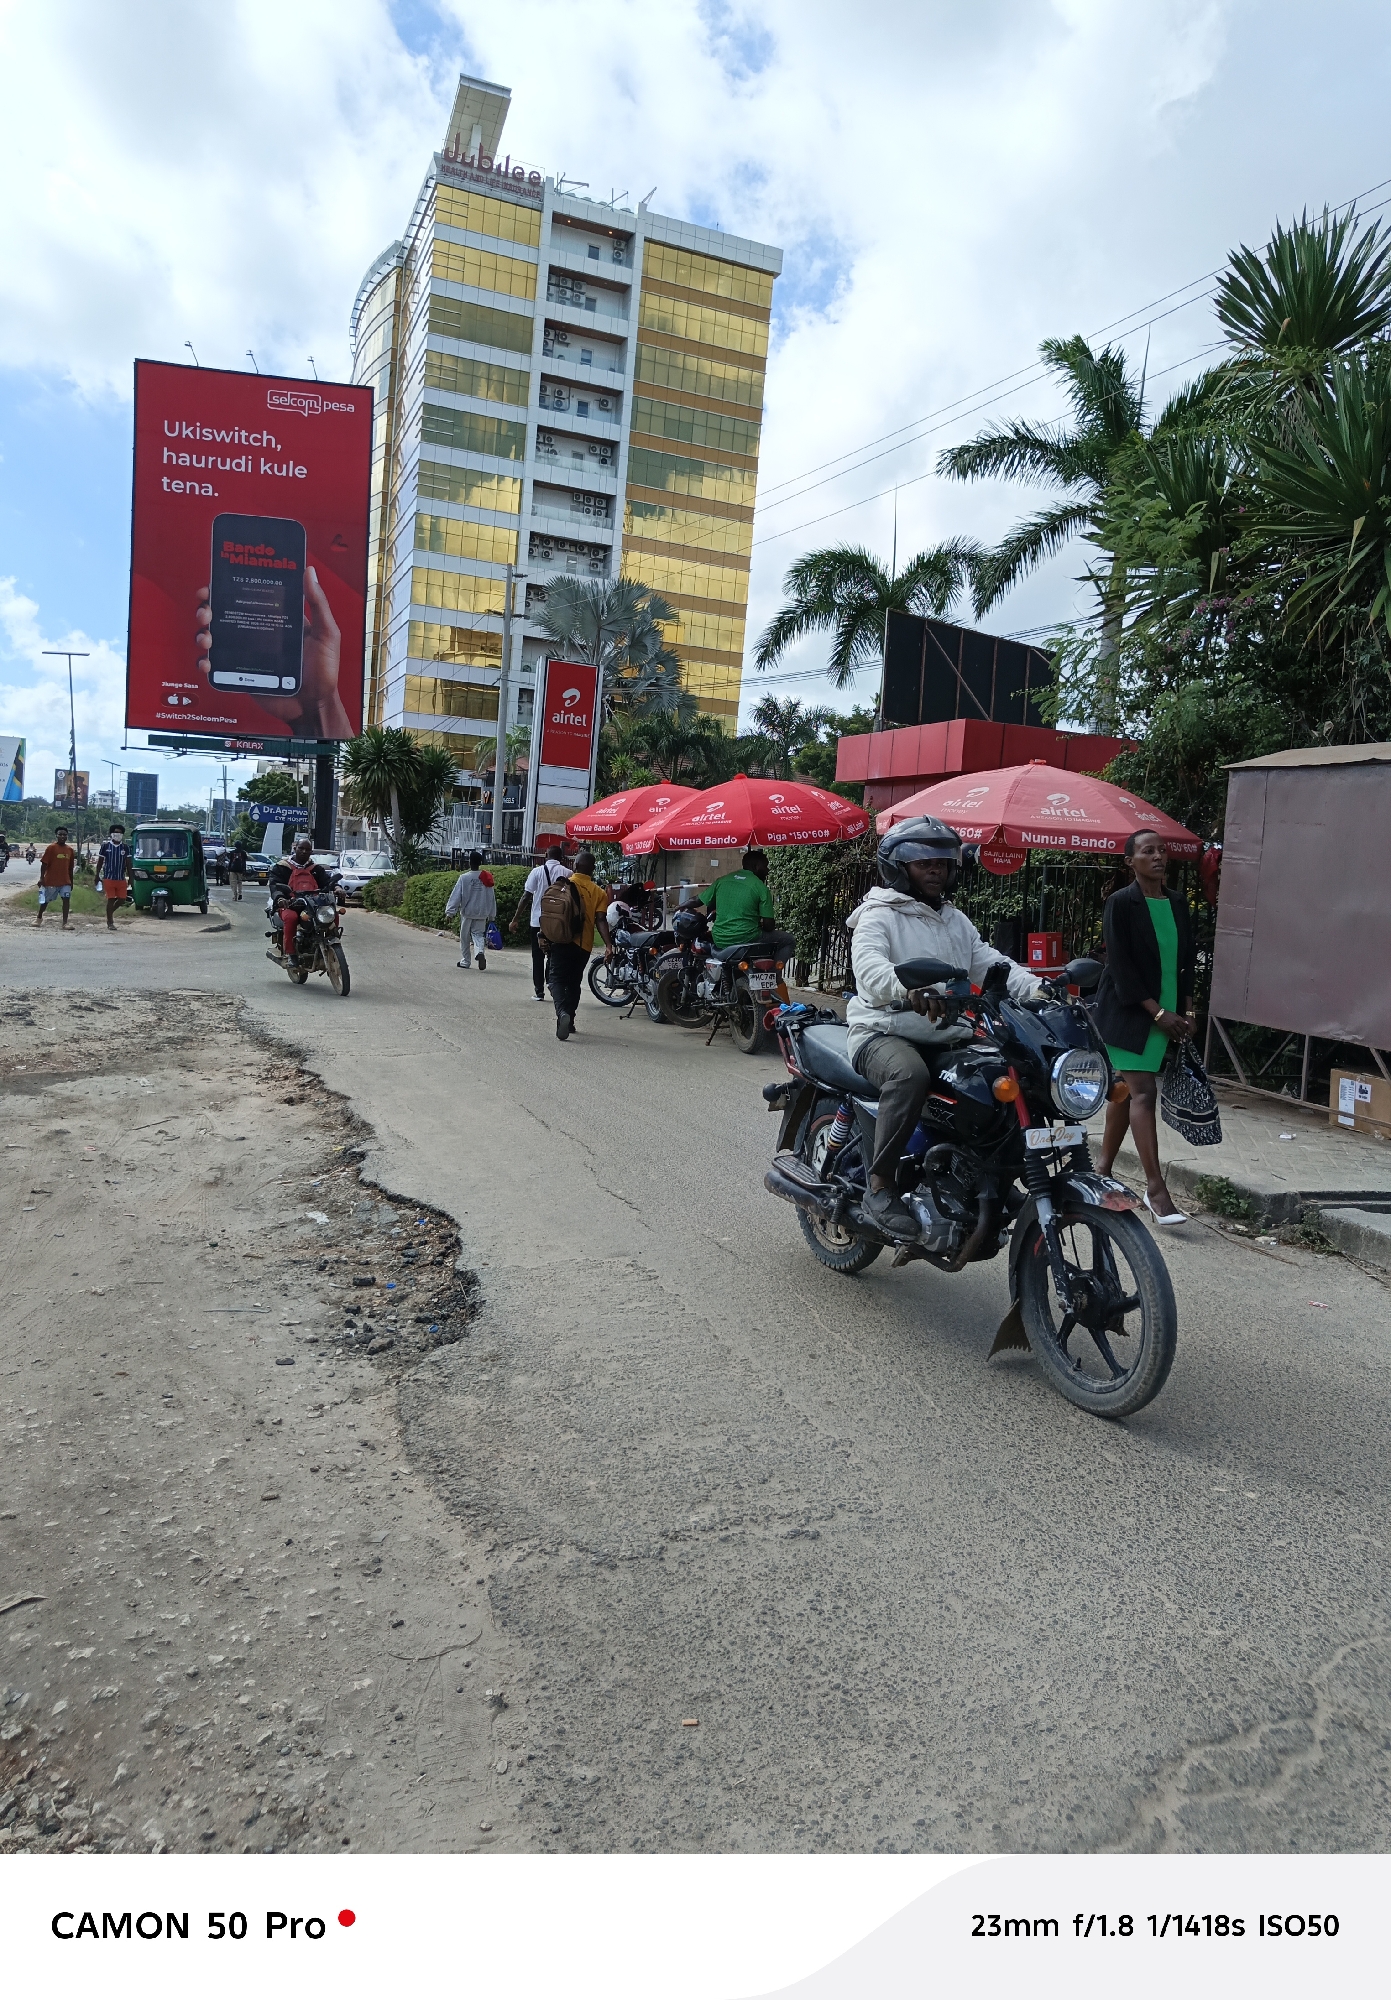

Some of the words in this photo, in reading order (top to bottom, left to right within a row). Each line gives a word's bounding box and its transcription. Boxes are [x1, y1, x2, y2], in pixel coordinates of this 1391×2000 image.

[444, 132, 541, 187] Jubilee
[271, 391, 321, 416] selcom
[323, 400, 355, 413] pesa
[163, 420, 282, 451] Ukiswitch,
[162, 447, 252, 473] haurudi
[260, 457, 308, 479] kule
[161, 476, 219, 497] tena.
[223, 541, 275, 556] Bando
[229, 553, 297, 570] Miamala
[155, 712, 238, 724] #Switch2SelcomPesa
[552, 710, 587, 727] airtel
[236, 741, 264, 750] KALAX
[770, 805, 802, 815] airtel
[942, 799, 984, 808] airtel
[263, 806, 309, 816] Dr.Agarwa
[691, 812, 727, 822] airtel
[1040, 807, 1088, 818] airtel
[573, 824, 592, 832] Nunua
[593, 824, 614, 832] Bando
[669, 837, 702, 846] Nunua
[704, 835, 738, 845] Bando
[767, 832, 787, 842] Piga
[1021, 832, 1067, 845] Nunua
[1071, 835, 1116, 849] Bando
[938, 1069, 957, 1083] TVS
[1030, 1129, 1052, 1147] One
[1053, 1126, 1076, 1143] Day
